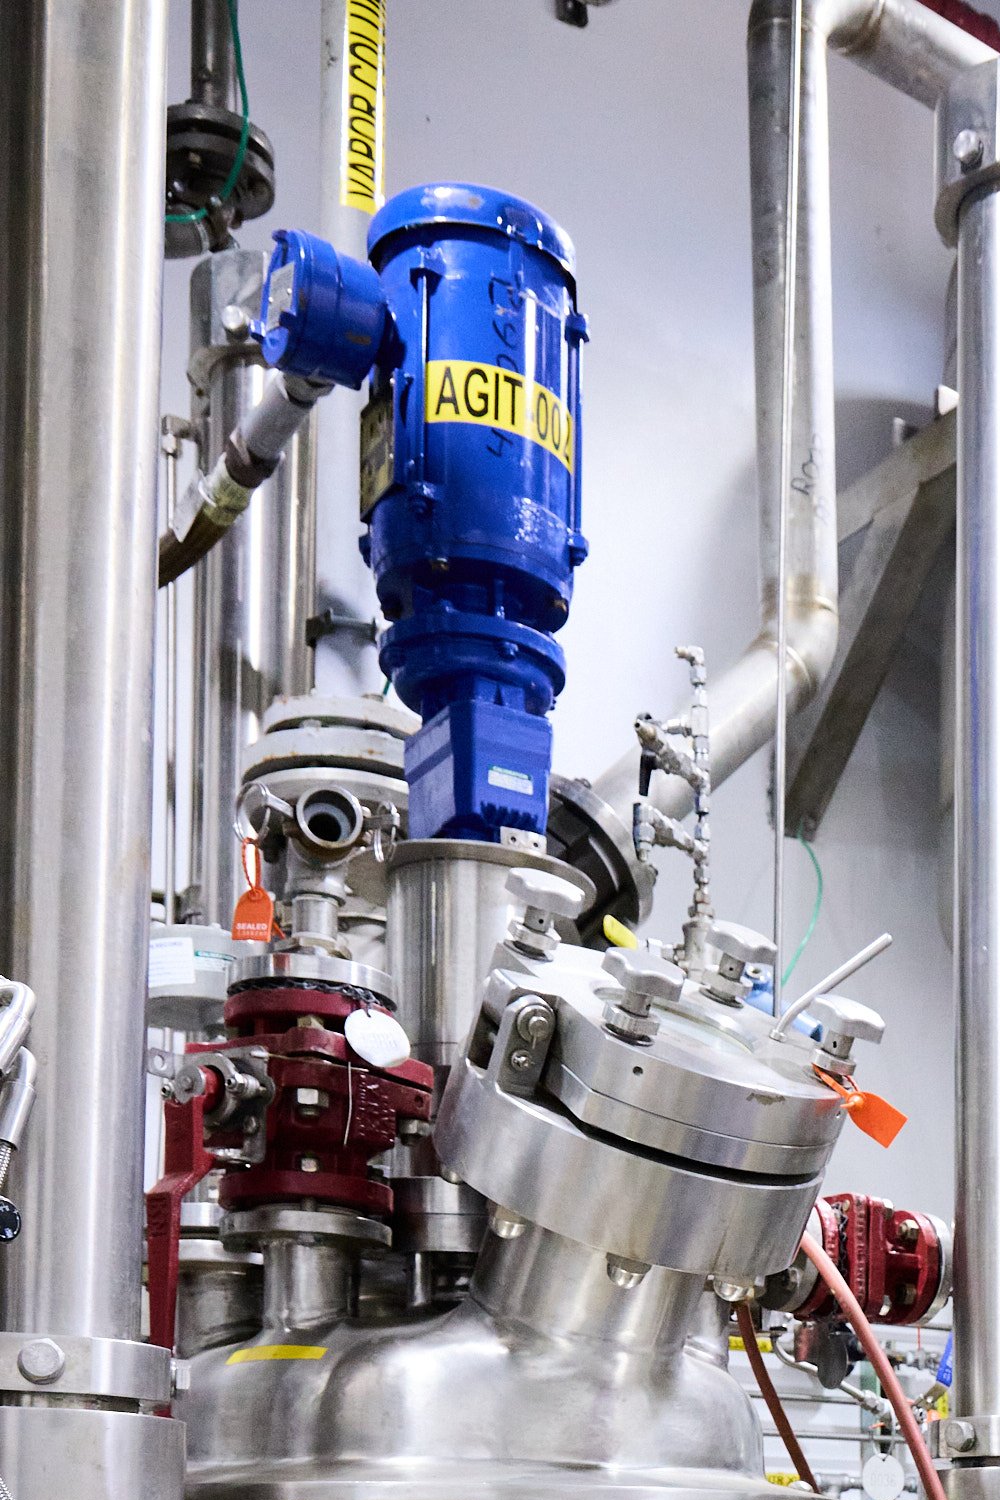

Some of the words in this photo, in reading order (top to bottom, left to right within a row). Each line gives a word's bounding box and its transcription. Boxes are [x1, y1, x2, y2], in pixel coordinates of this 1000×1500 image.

[349, 0, 385, 91] COLU
[348, 94, 377, 199] VAPOR
[236, 922, 268, 931] SEALED
